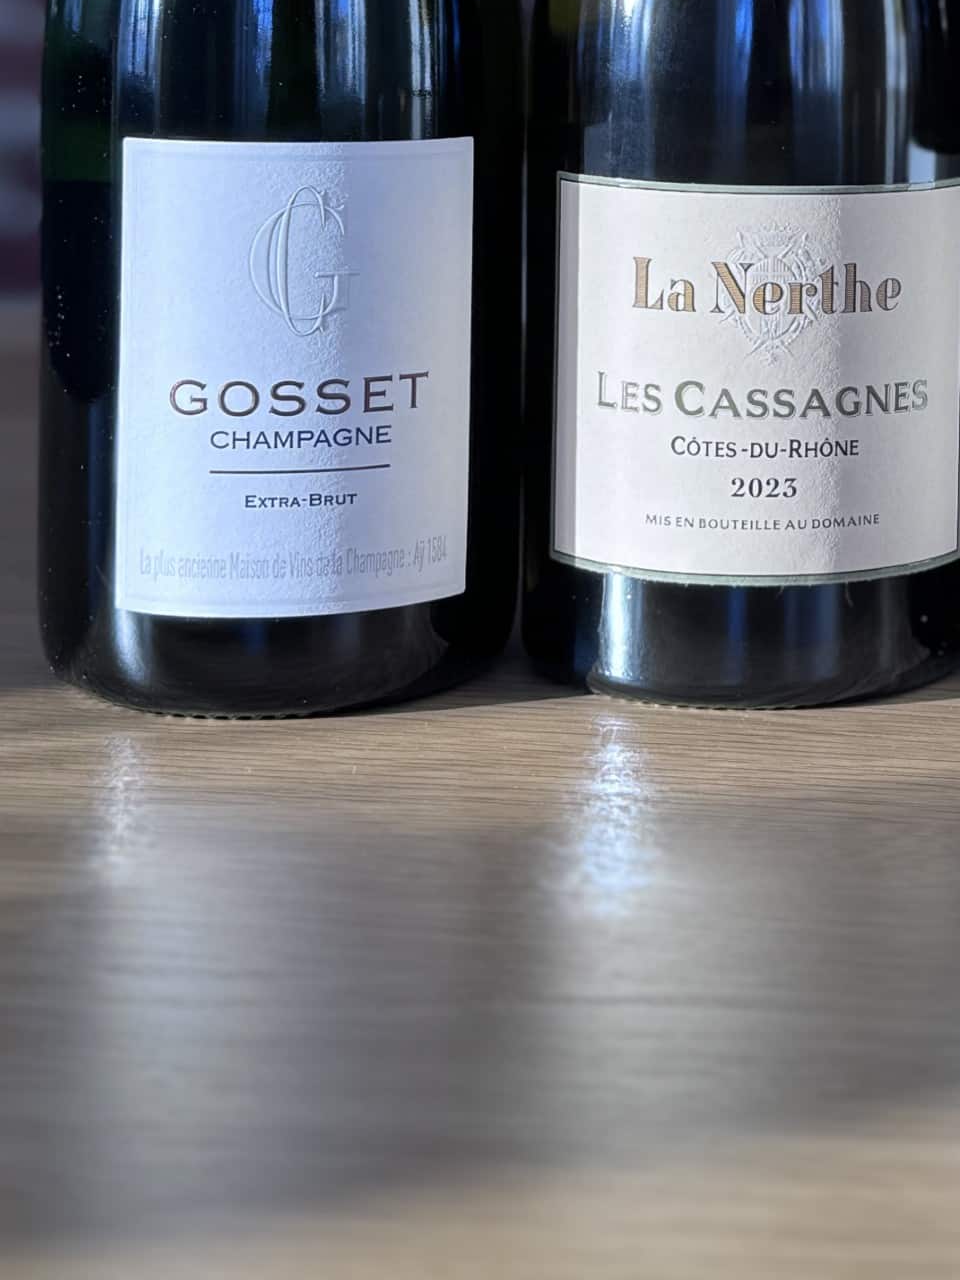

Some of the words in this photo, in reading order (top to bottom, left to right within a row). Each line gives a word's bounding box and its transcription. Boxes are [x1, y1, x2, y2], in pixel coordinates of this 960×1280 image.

[632, 256, 696, 314] La
[710, 262, 902, 316] Nerthe
[169, 371, 429, 417] GOSSET
[597, 371, 662, 415] LES
[674, 379, 928, 419] CASSAGNES
[210, 425, 392, 451] CHAMPAGNE
[731, 477, 798, 499] 2023
[646, 514, 671, 526] MIS
[676, 516, 695, 528] EN
[699, 518, 780, 530] BOUTEILLE
[784, 519, 807, 531] AU
[812, 514, 880, 529] DOMAINE
[230, 551, 269, 579] Maison
[272, 551, 287, 579] de
[289, 551, 313, 578] Vins
[346, 547, 405, 577] Champagne
[427, 535, 448, 565] 1584
